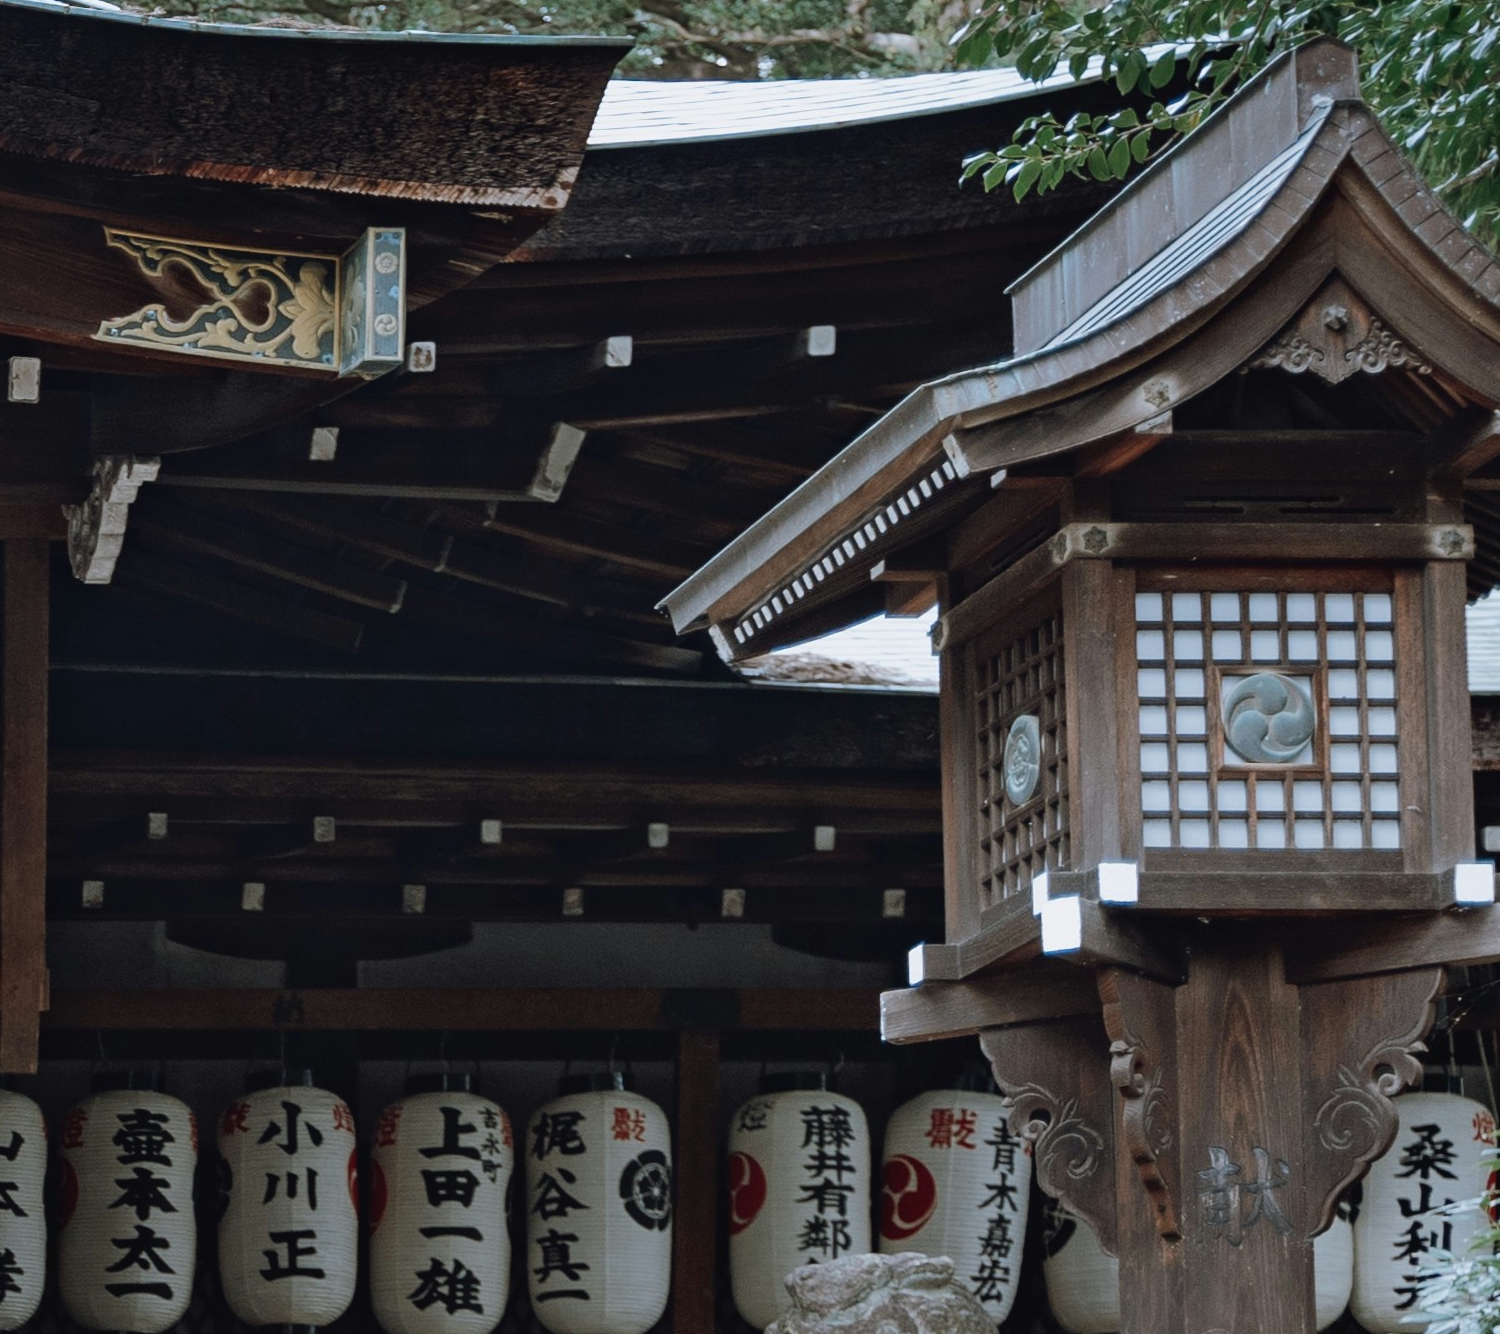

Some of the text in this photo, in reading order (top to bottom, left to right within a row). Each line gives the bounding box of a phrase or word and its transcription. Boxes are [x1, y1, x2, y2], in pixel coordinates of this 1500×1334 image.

[257, 1100, 326, 1282] 小川正
[406, 1106, 484, 1316] 上田一雄
[531, 1110, 591, 1304] 梶谷真一
[795, 1104, 855, 1266] 藤井有鄰
[971, 1117, 1021, 1303] 青木嘉宏
